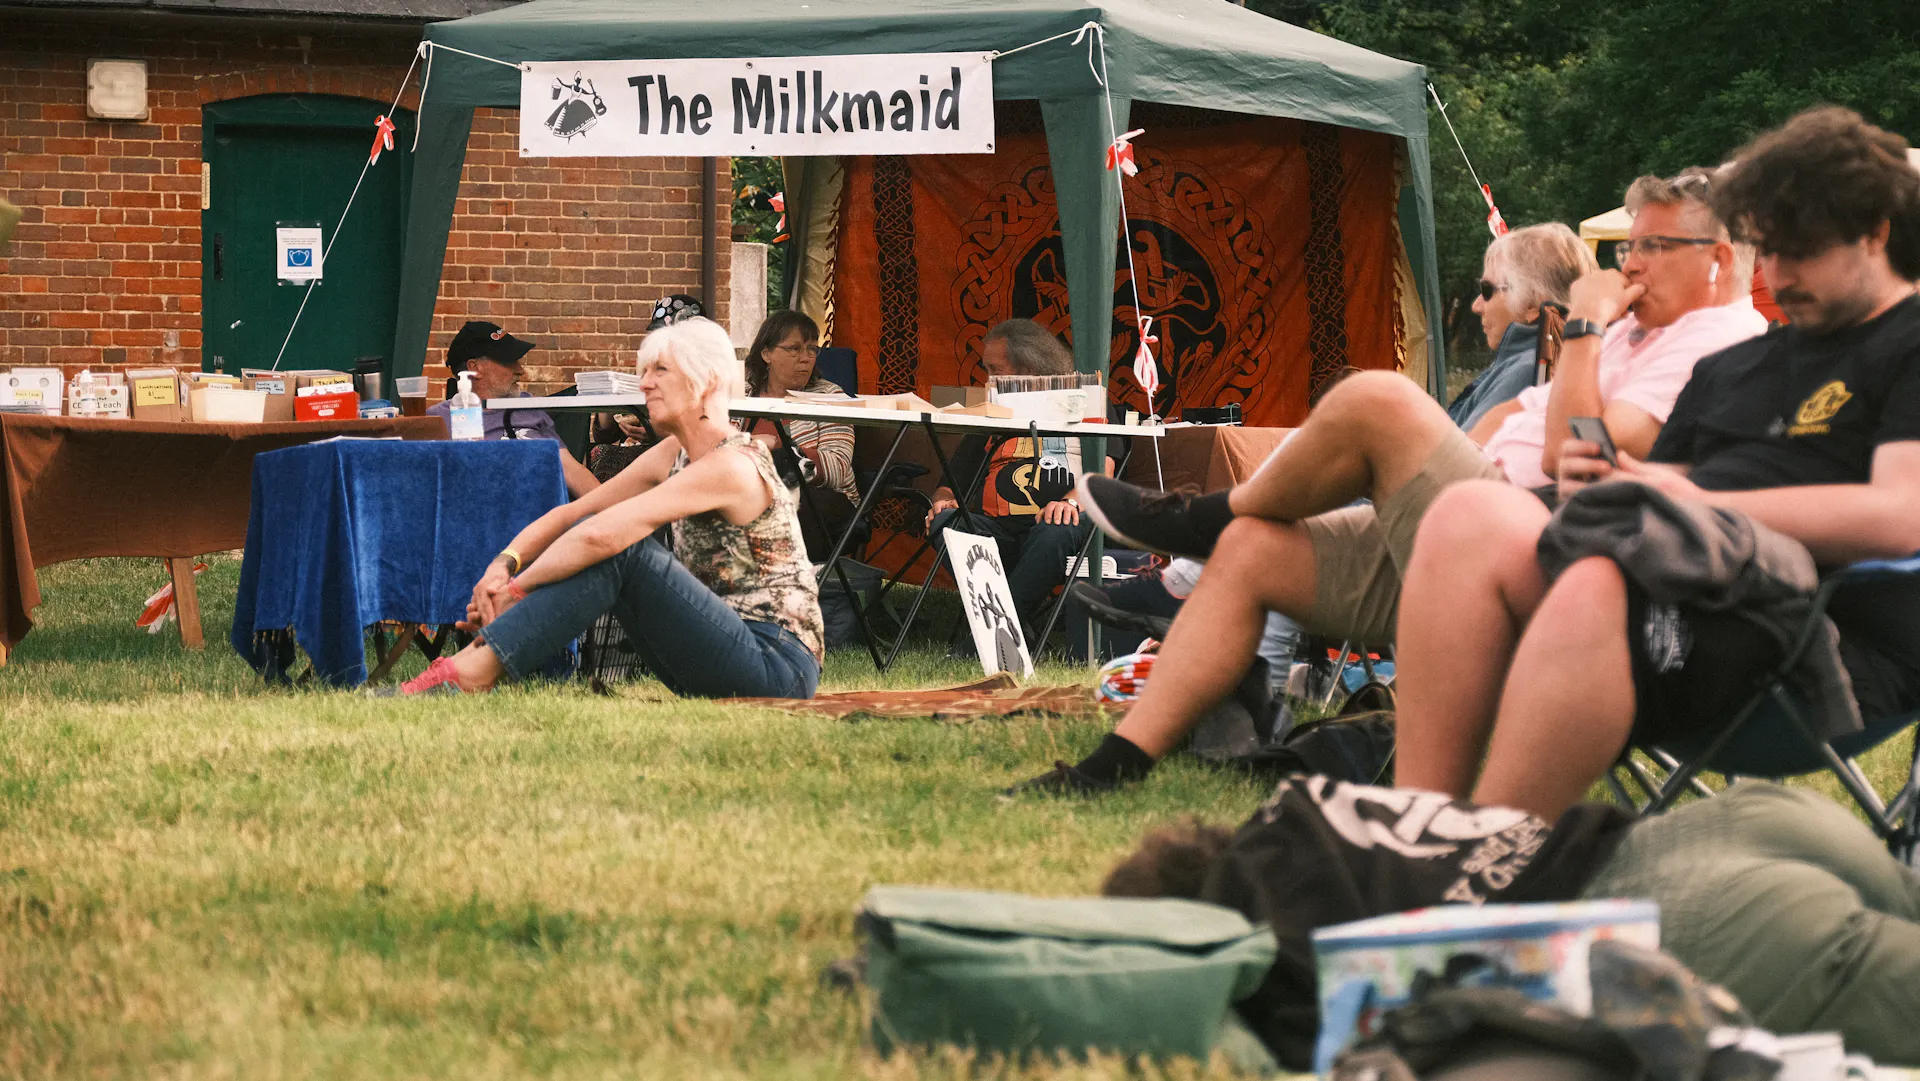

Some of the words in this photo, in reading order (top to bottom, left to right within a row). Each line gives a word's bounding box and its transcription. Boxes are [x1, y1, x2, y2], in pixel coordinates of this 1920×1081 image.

[627, 74, 713, 136] The
[731, 66, 962, 136] Milkmaid
[103, 401, 122, 409] each
